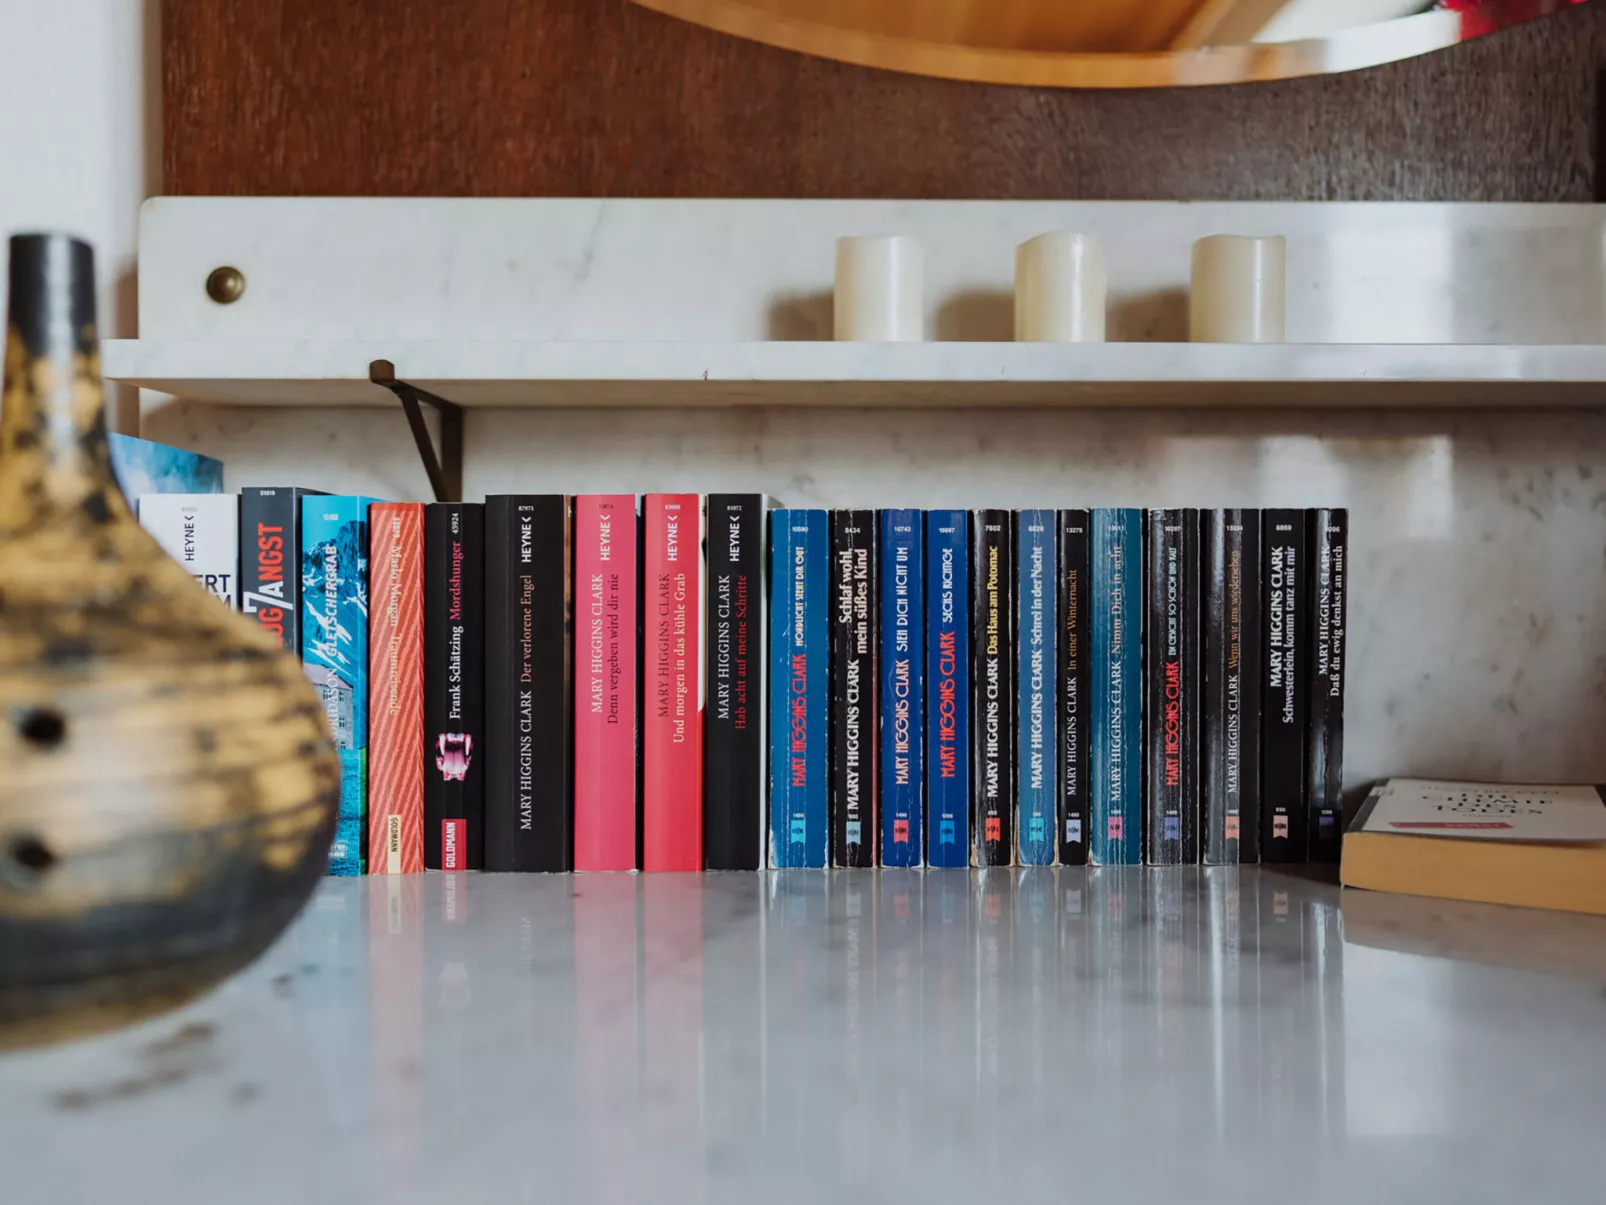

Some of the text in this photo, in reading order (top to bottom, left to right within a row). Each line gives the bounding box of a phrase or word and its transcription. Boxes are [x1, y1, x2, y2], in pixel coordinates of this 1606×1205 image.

[184, 523, 194, 561] HEYNE
[522, 524, 532, 563] HEYNE
[600, 522, 611, 561] HEYNE
[667, 523, 678, 561] HEYNE
[729, 523, 740, 562] HEYNE
[795, 546, 804, 565] GUT
[896, 547, 909, 562] UM
[1111, 546, 1122, 570] acht
[1283, 546, 1296, 566] mir
[391, 545, 403, 581] Marlo
[449, 541, 464, 620] Mordshunger
[896, 565, 909, 595] NICHT
[987, 546, 998, 590] Potomac
[1031, 547, 1042, 578] Nacht
[1228, 550, 1238, 605] wiedersehen
[1283, 568, 1296, 586] mit
[325, 545, 337, 657] GLETSCHERGRAB
[388, 583, 402, 628] Morgan
[839, 584, 853, 624] Schlaf
[854, 549, 868, 654] mein süßes Kind
[942, 591, 953, 623] SECHS
[989, 591, 998, 608] am
[1031, 579, 1042, 598] der
[1111, 588, 1122, 615] Dich
[1283, 588, 1296, 611] tanz
[896, 599, 909, 626] DICH
[987, 609, 998, 634] Haus
[1168, 603, 1176, 616] SO
[1270, 546, 1282, 687] MARY HIGGINS CLARK
[1319, 546, 1330, 675] MARY HIGGINS CLARK
[1330, 546, 1344, 696] Daß du ewig denkst an mich
[592, 574, 603, 713] MARY HIGGINS CLARK
[607, 573, 621, 724] Denn vergeben wird dir nie
[658, 574, 670, 718] MARY HIGGINS CLARK
[718, 575, 730, 719] MARY HIGGINS CLARK
[987, 635, 998, 655] Das
[1111, 618, 1122, 654] Nimm
[1230, 625, 1238, 640] wir
[1283, 614, 1296, 648] komm
[449, 625, 464, 682] Schätzing
[674, 573, 688, 743] Und morgen in das kühle Grab
[735, 575, 746, 730] Hab acht auf meine Schritte
[940, 631, 955, 676] CLARK
[1031, 649, 1042, 690] CLARK
[1228, 642, 1238, 669] Wenn
[390, 633, 402, 717] Traumreisende
[792, 653, 806, 694] CLARK
[847, 659, 859, 704] CLARK
[896, 659, 909, 698] CLARK
[987, 658, 998, 700] CLARK
[1067, 570, 1076, 795] MARY HIGGINS CLARK In einer Winternacht
[1111, 660, 1122, 703] CLARK
[1165, 661, 1179, 700] CLARK
[1228, 674, 1238, 711] CLARK
[449, 684, 461, 719] Frank
[521, 575, 534, 830] MARY HIGGINS CLARK Der verlorene Engel
[940, 678, 955, 741] HIGGINS
[1031, 693, 1042, 748] HIGGINS
[792, 696, 806, 752] HIGGINS
[847, 706, 859, 766] HIGGINS
[896, 700, 909, 753] HIGGINS
[987, 701, 998, 757] HIGGINS
[1111, 707, 1122, 763] HIGGINS
[1165, 701, 1179, 754] HIGGINS
[1228, 714, 1238, 760] HIGGINS
[792, 757, 806, 787] MARY
[896, 756, 909, 785] MARY
[940, 744, 955, 778] MARY
[987, 760, 998, 798] MARY
[1031, 751, 1042, 788] MARY
[1165, 758, 1179, 786] MARY
[1228, 763, 1238, 793] MARY
[847, 768, 859, 810] MARY
[1111, 767, 1122, 801] MARY
[390, 817, 398, 852] GOLDMANN
[446, 822, 456, 868] GOLDMANN
